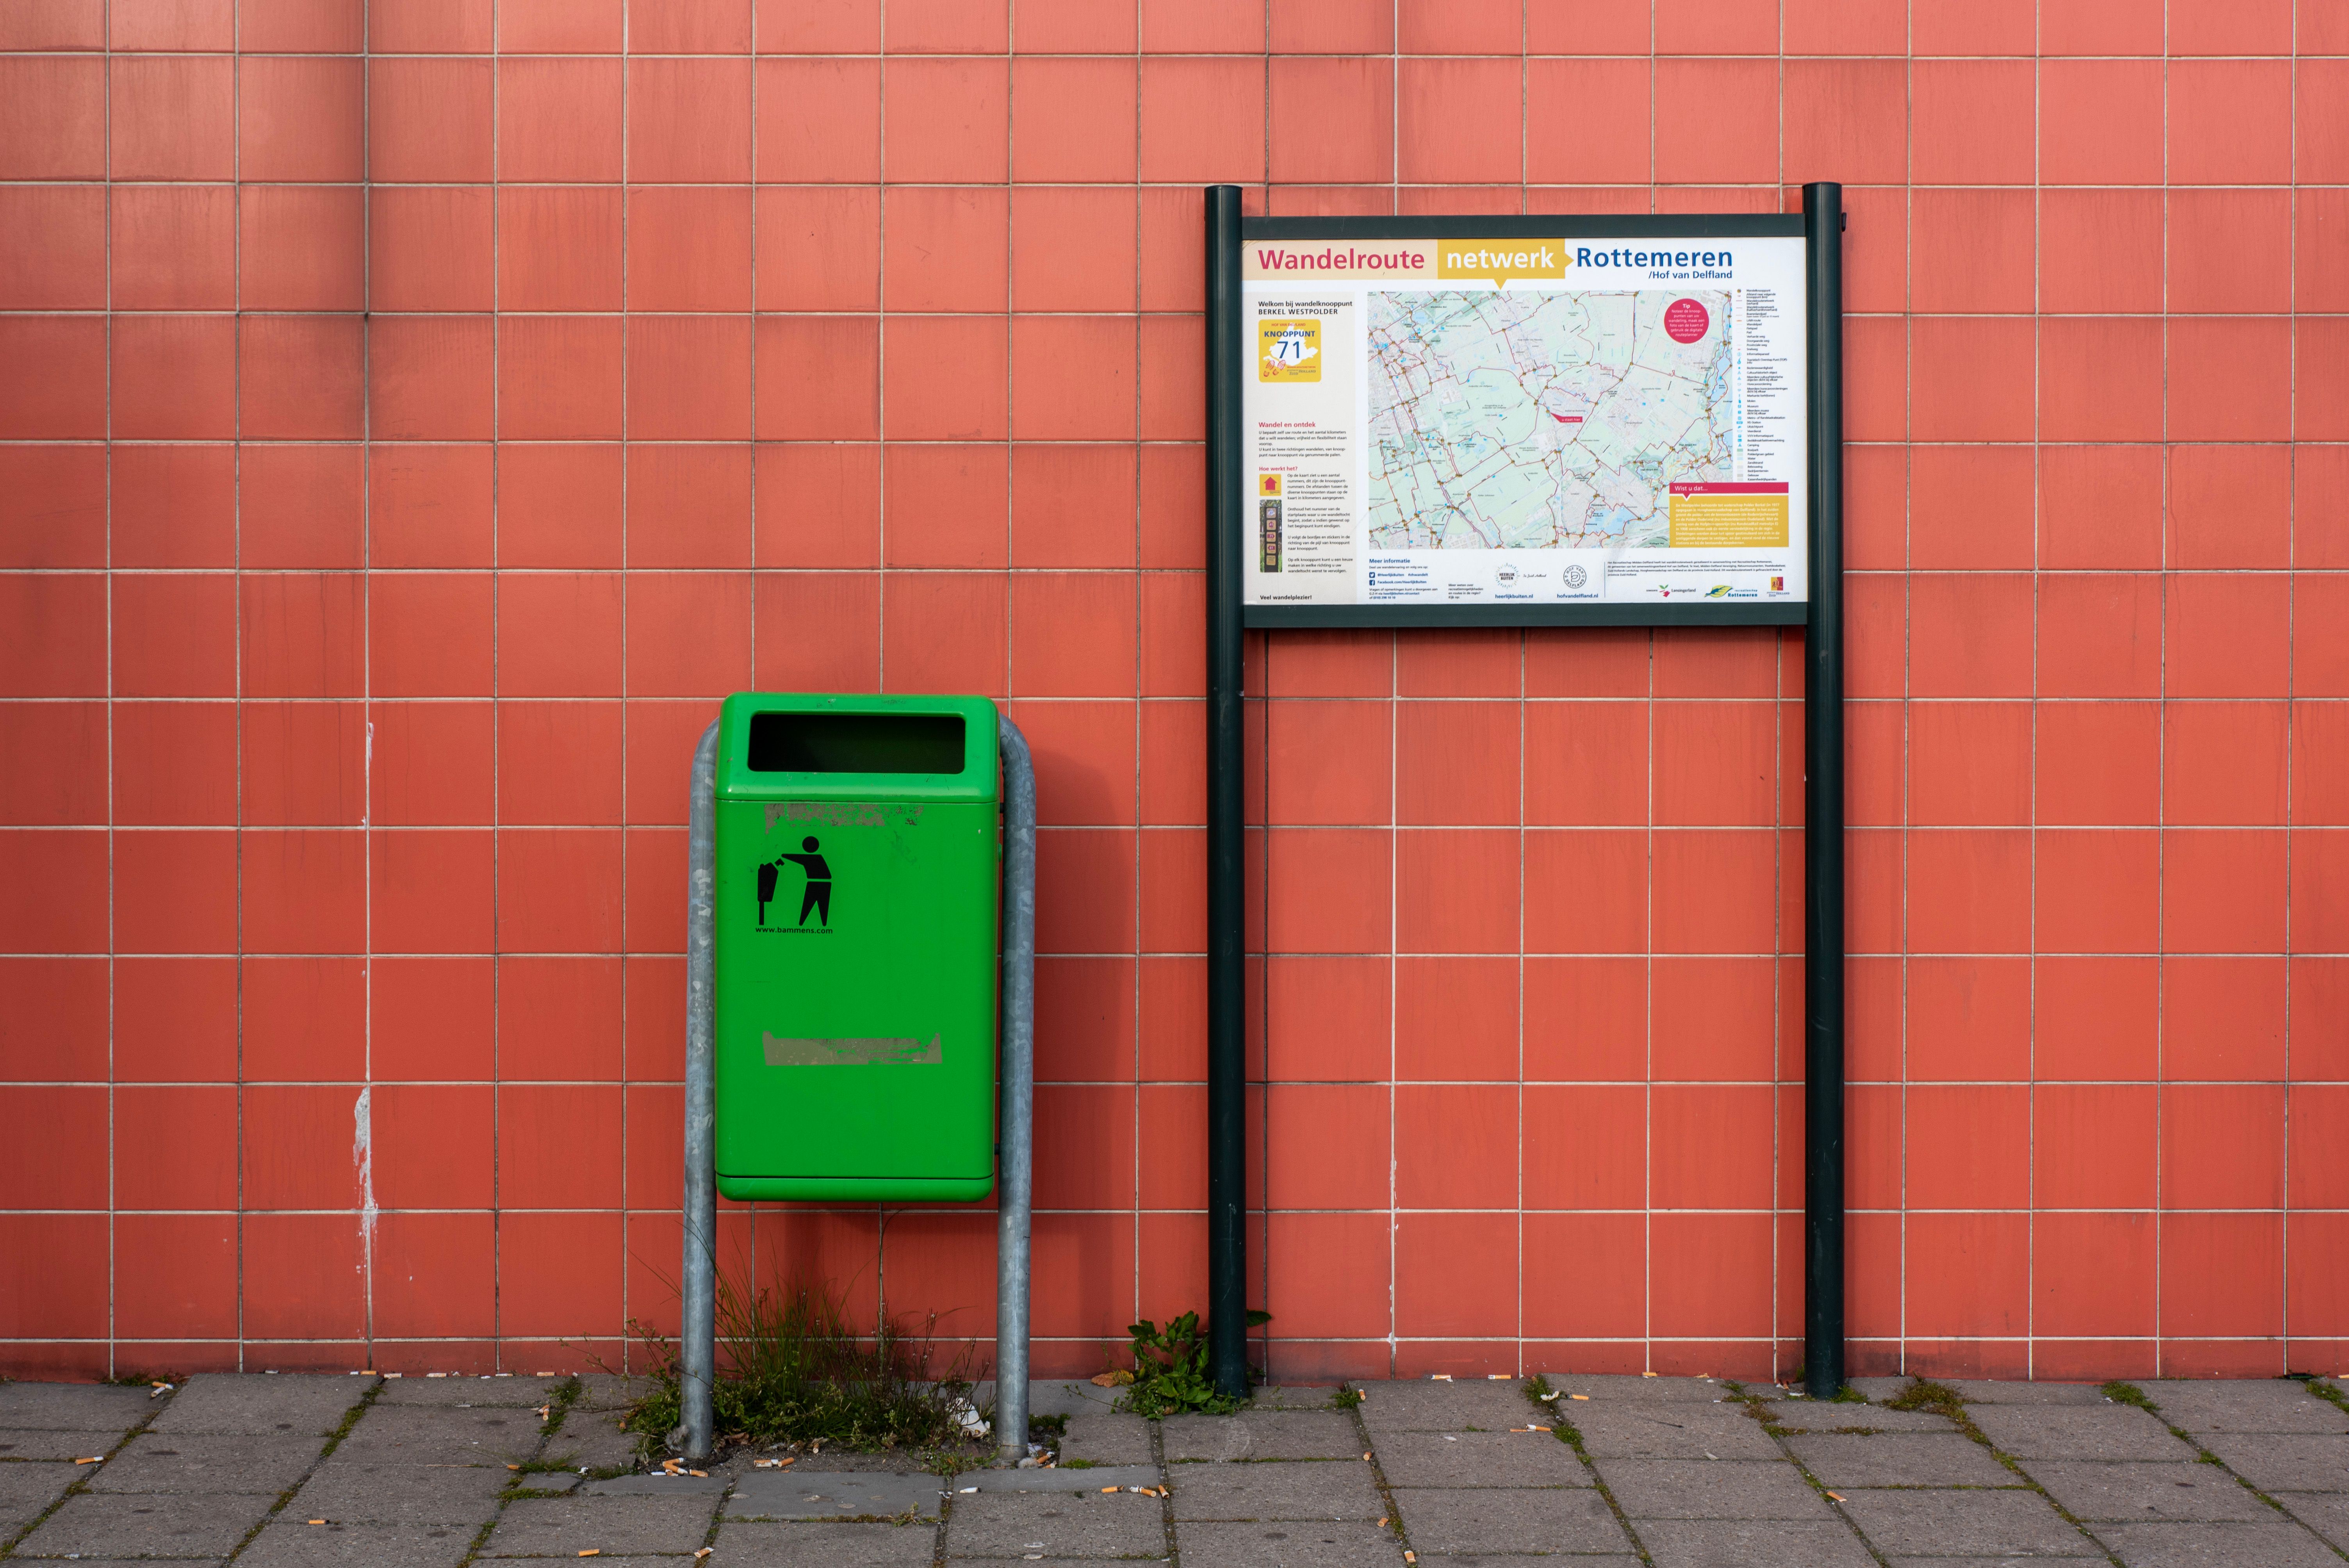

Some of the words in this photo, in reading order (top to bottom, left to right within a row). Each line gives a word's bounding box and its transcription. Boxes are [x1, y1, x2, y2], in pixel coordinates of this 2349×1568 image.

[1258, 248, 1424, 270] Wandelroute
[1447, 246, 1554, 269] netwerk
[1577, 248, 1732, 267] Rottemeren
[1649, 271, 1670, 279] /Hof
[1693, 270, 1732, 278] Delfland
[1277, 341, 1299, 358] 71
